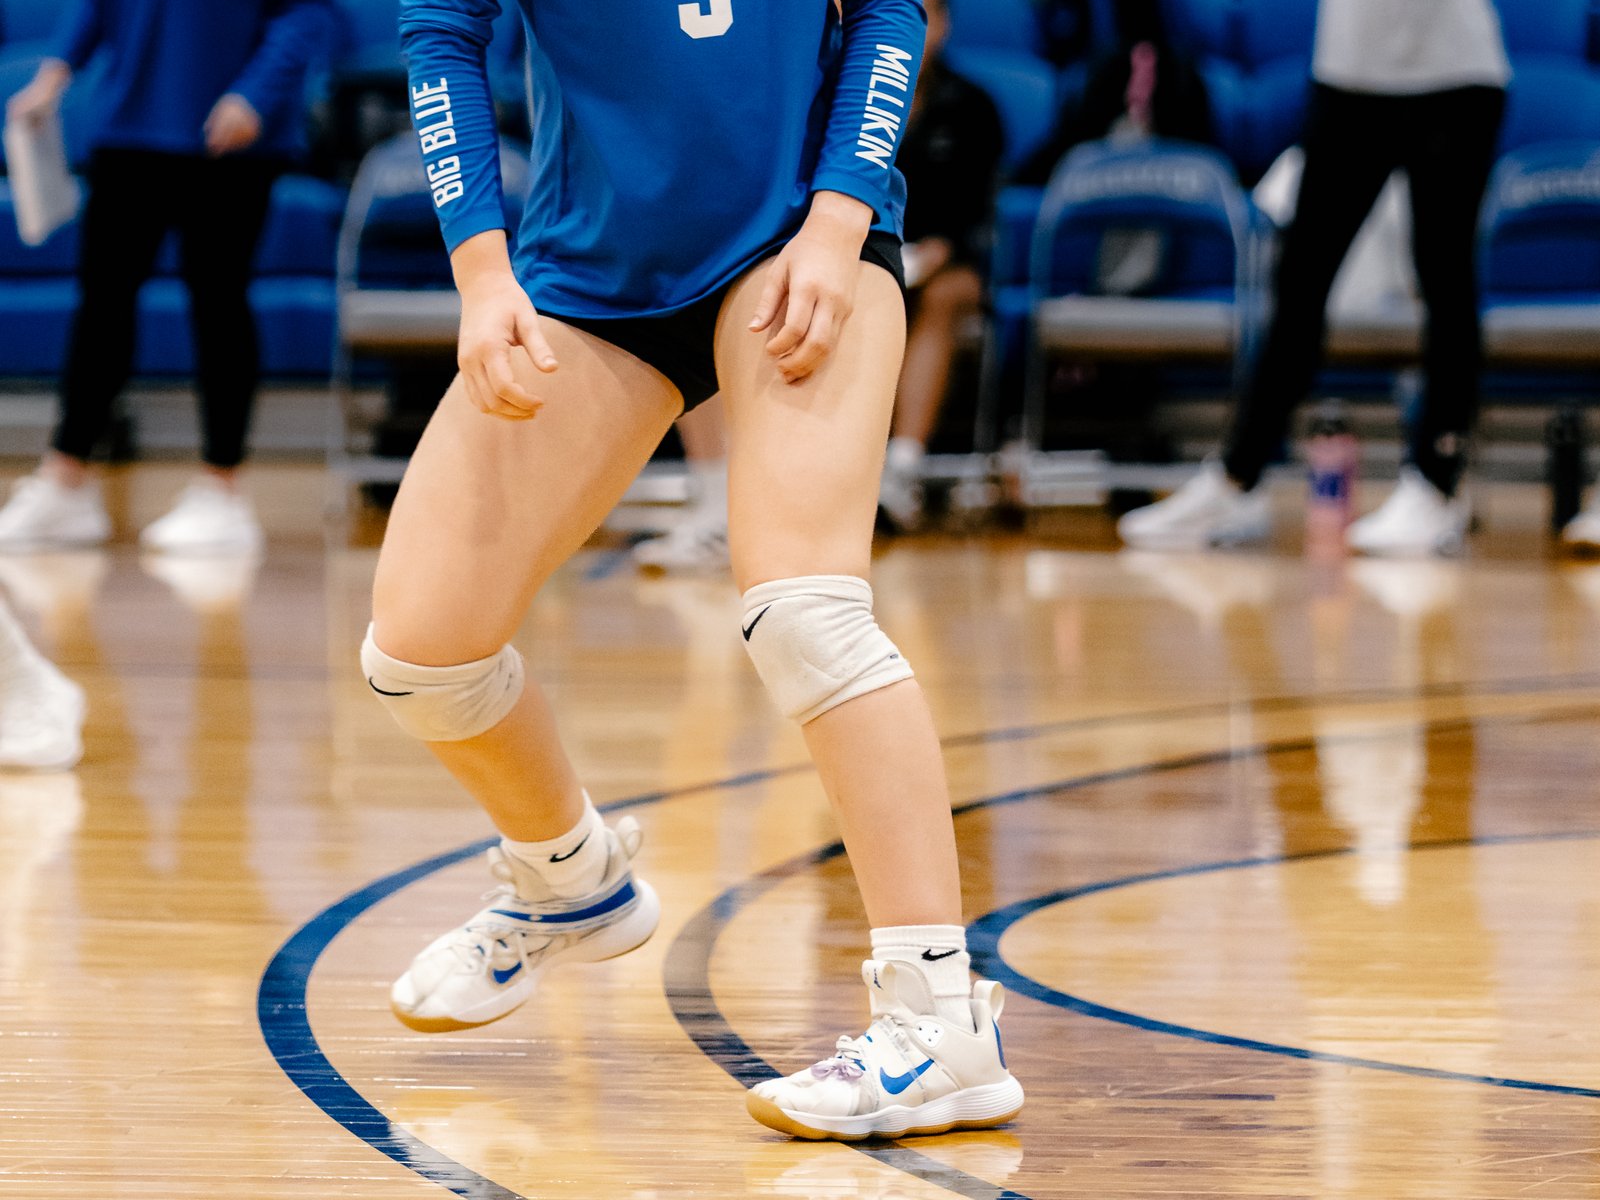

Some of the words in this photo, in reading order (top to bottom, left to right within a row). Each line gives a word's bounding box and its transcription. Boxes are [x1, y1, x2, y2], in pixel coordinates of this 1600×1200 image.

[412, 77, 457, 154] BLUE
[855, 44, 912, 170] MILLIKIN
[427, 155, 464, 208] BIG
